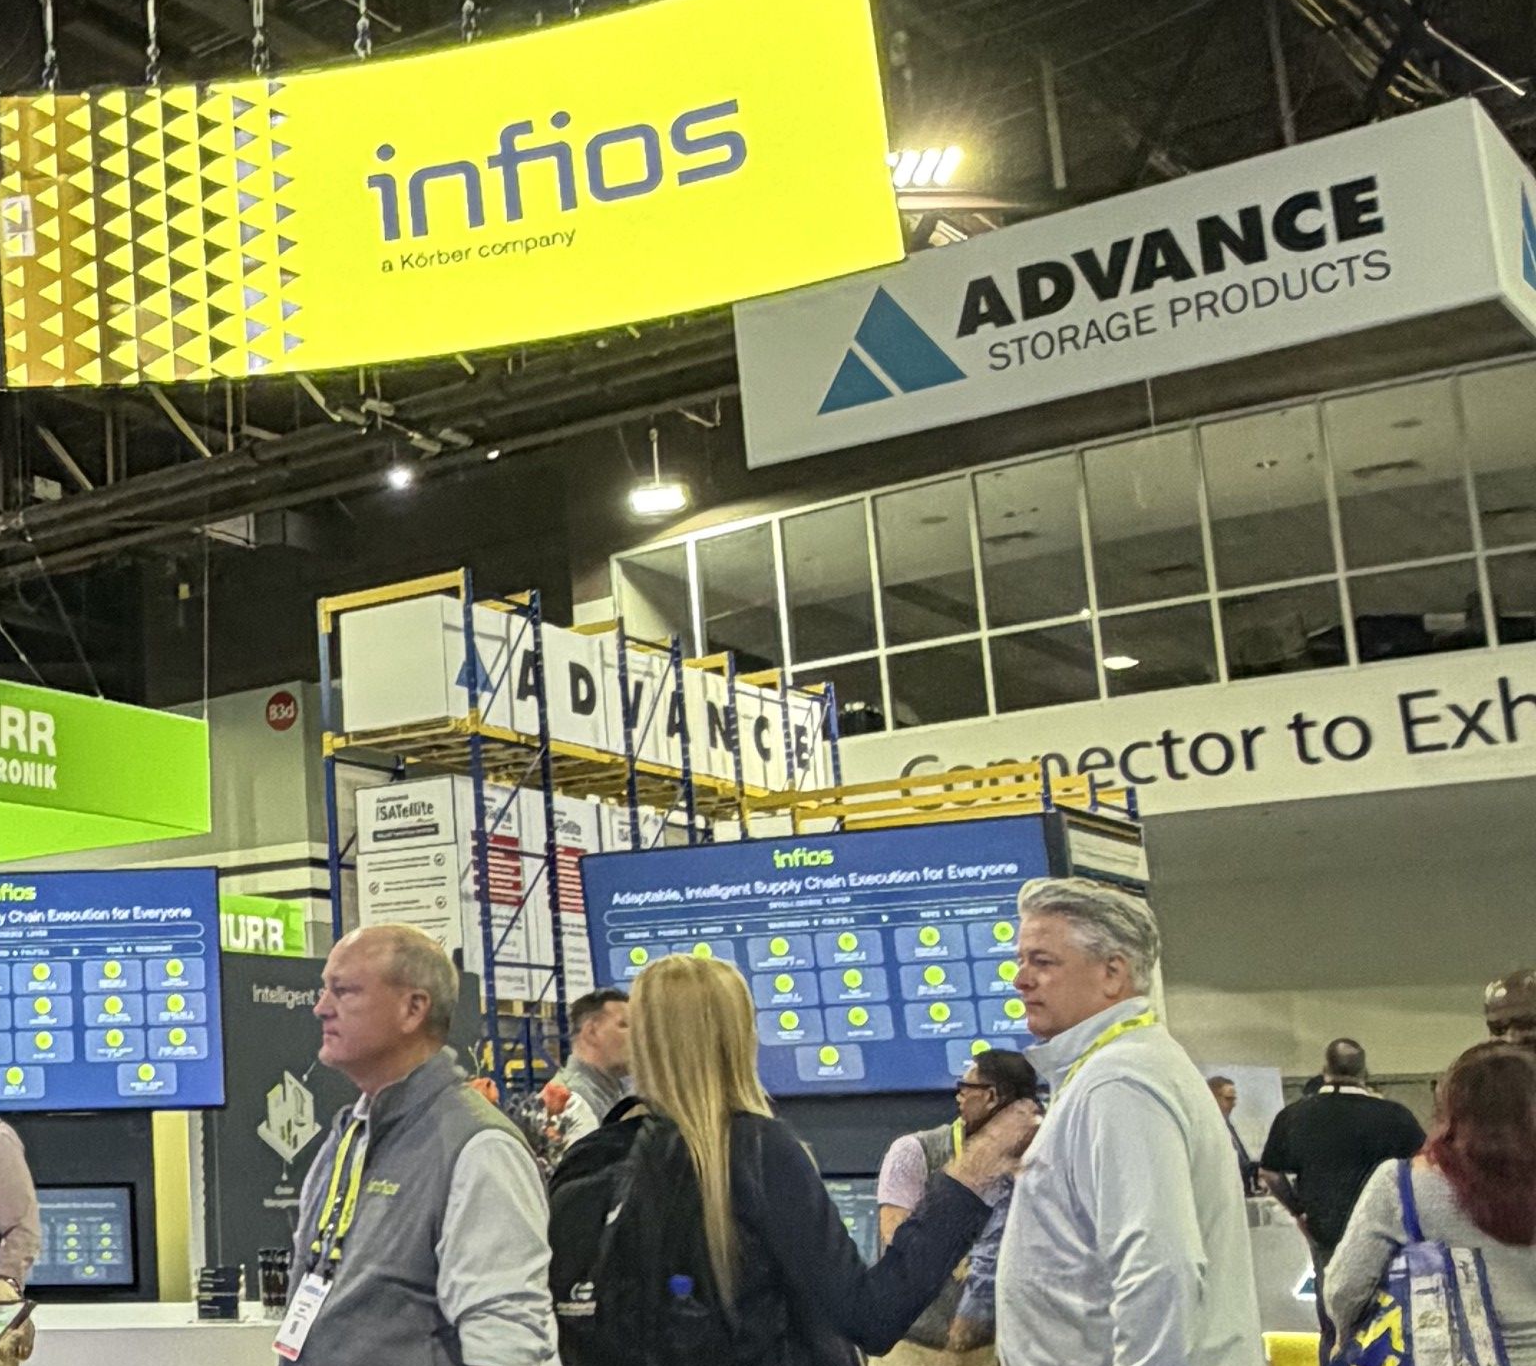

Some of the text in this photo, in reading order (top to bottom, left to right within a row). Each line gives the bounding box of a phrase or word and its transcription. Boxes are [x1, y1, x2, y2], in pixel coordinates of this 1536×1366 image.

[368, 99, 748, 241] infios
[381, 228, 577, 273] a Körber company
[956, 175, 1385, 339] ADVANCE
[988, 249, 1392, 372] STORAGE PRODUCTS
[1286, 712, 1373, 765] to
[1397, 676, 1536, 754] Exh
[685, 882, 752, 900] Intelligent
[754, 878, 802, 895] Supply
[804, 874, 847, 891] Chain
[848, 870, 921, 888] Execution
[923, 866, 944, 882] for
[946, 862, 1019, 880] Everyone
[773, 847, 835, 869] infios
[7, 909, 46, 923] Chain
[47, 907, 110, 922] Execution
[110, 906, 129, 920] for
[132, 905, 193, 922] Everyone
